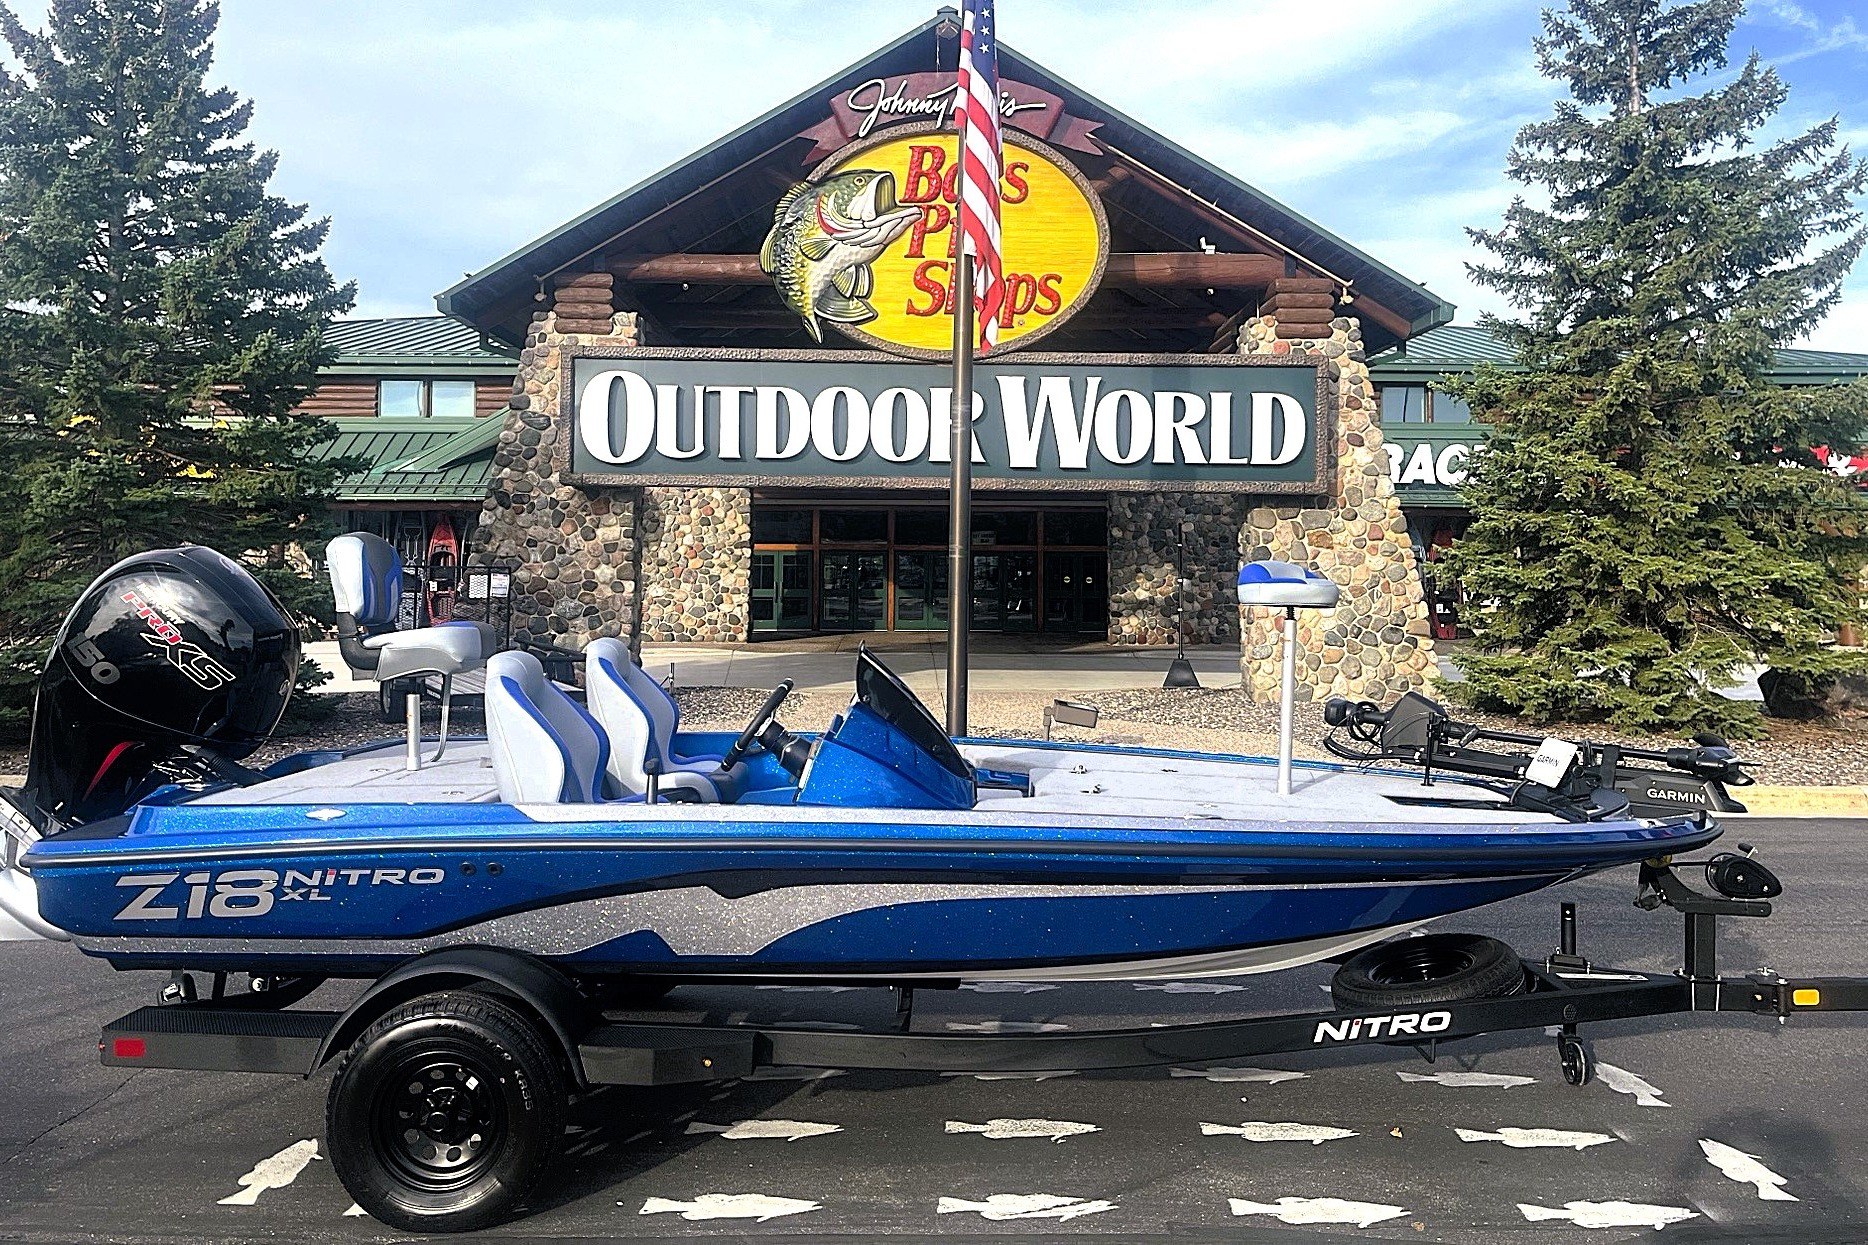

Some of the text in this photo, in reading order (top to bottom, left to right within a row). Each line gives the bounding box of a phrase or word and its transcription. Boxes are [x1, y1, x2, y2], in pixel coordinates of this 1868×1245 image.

[847, 79, 950, 138] Johnny
[899, 145, 1029, 204] Bs
[906, 260, 1062, 328] Sps
[580, 370, 1306, 469] OUTDOOR WORLD
[120, 590, 183, 644] PRO
[139, 632, 236, 690] XS
[1537, 754, 1560, 768] GARMIN
[1647, 788, 1706, 804] GARMIN
[113, 868, 445, 920] Z18 NITRO
[280, 888, 332, 901] XL
[1313, 1011, 1452, 1044] NITRO
